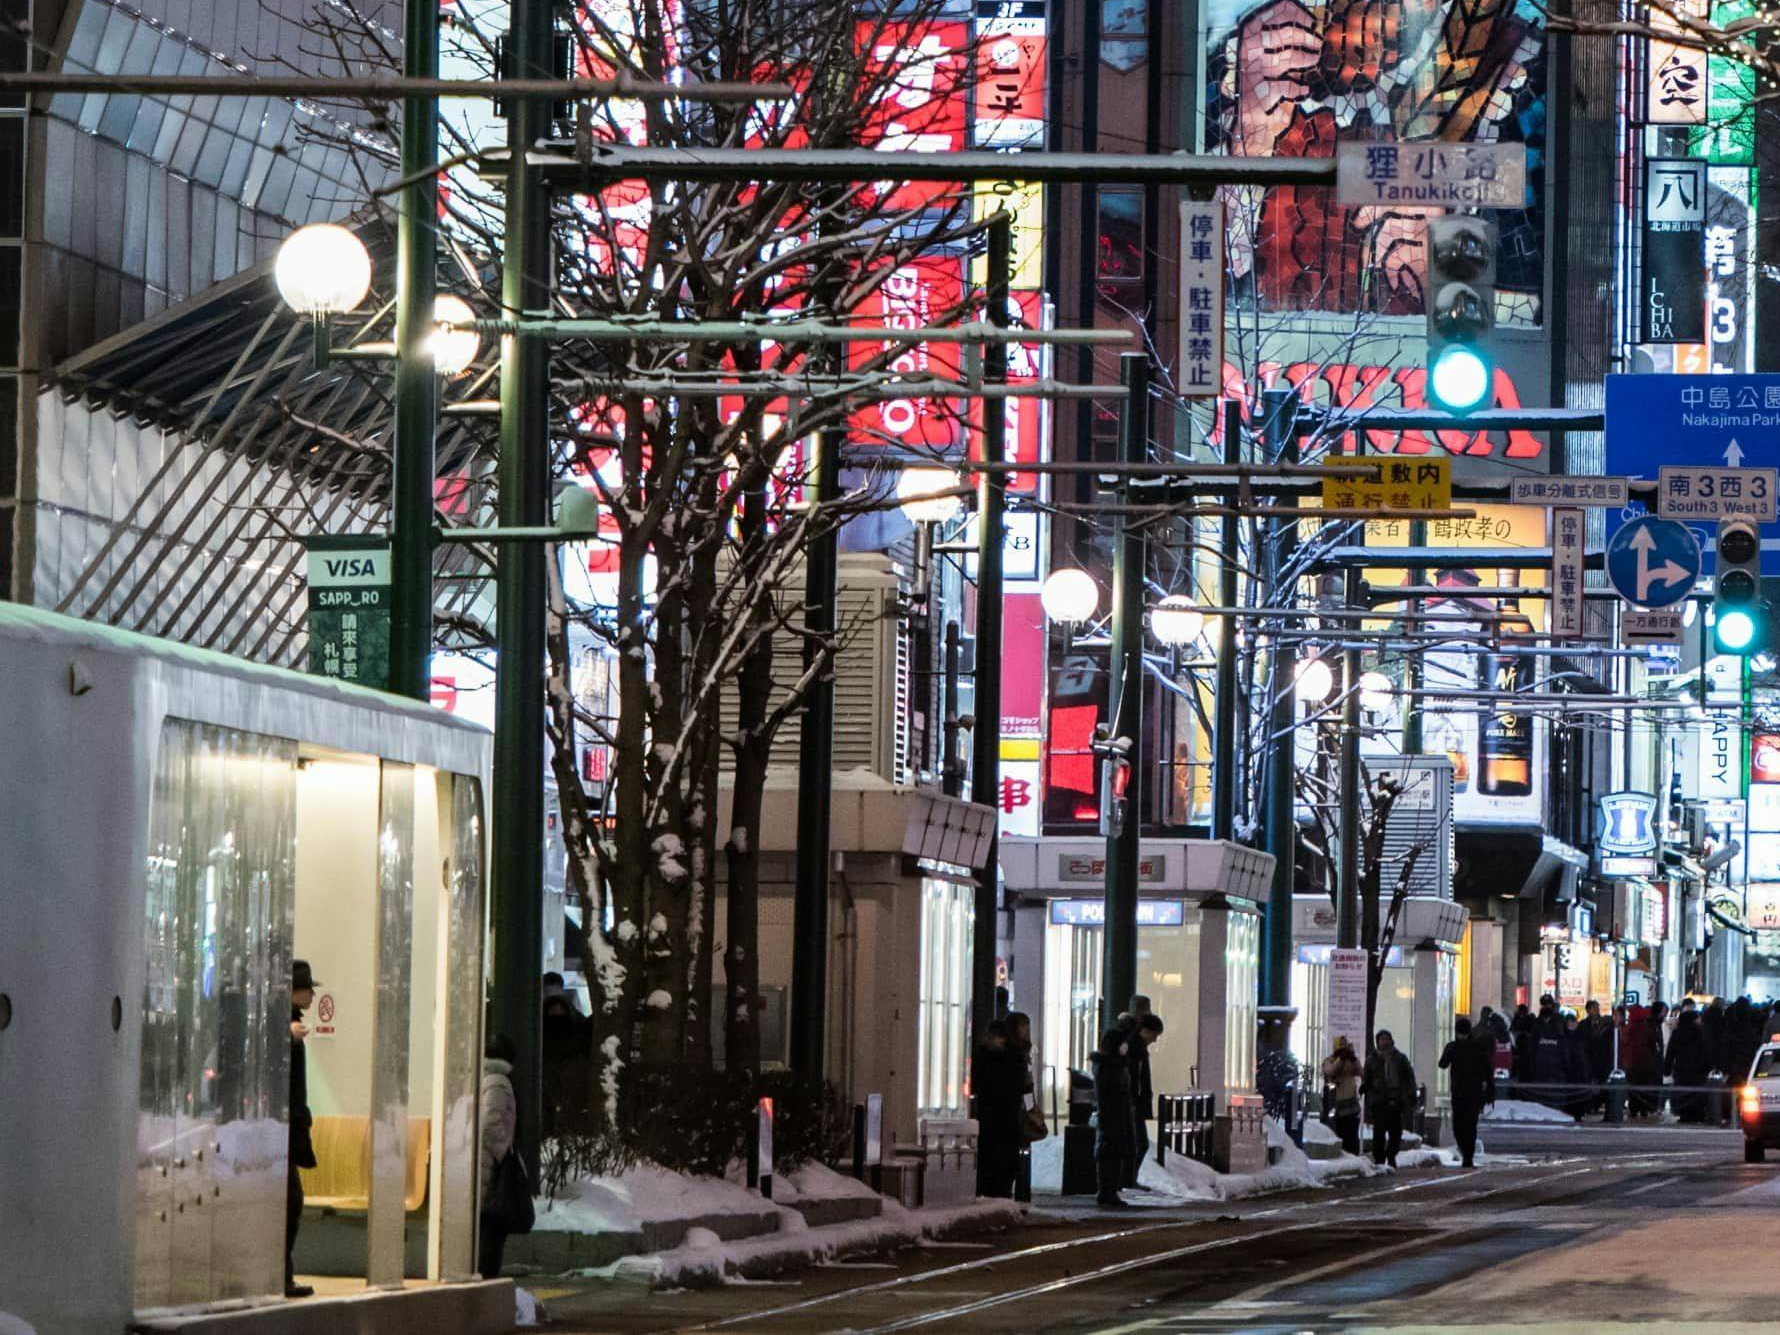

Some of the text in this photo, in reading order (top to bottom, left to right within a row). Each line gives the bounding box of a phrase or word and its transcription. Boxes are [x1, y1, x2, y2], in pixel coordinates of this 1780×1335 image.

[1682, 414, 1750, 428] Nakajima
[1518, 483, 1621, 500] 歩車分離式信号
[1434, 516, 1511, 539] 鶴政孝の
[325, 559, 376, 577] VISA
[324, 642, 340, 679] 札幌
[1712, 707, 1728, 784] HAPPY
[1082, 905, 1105, 921] POL
